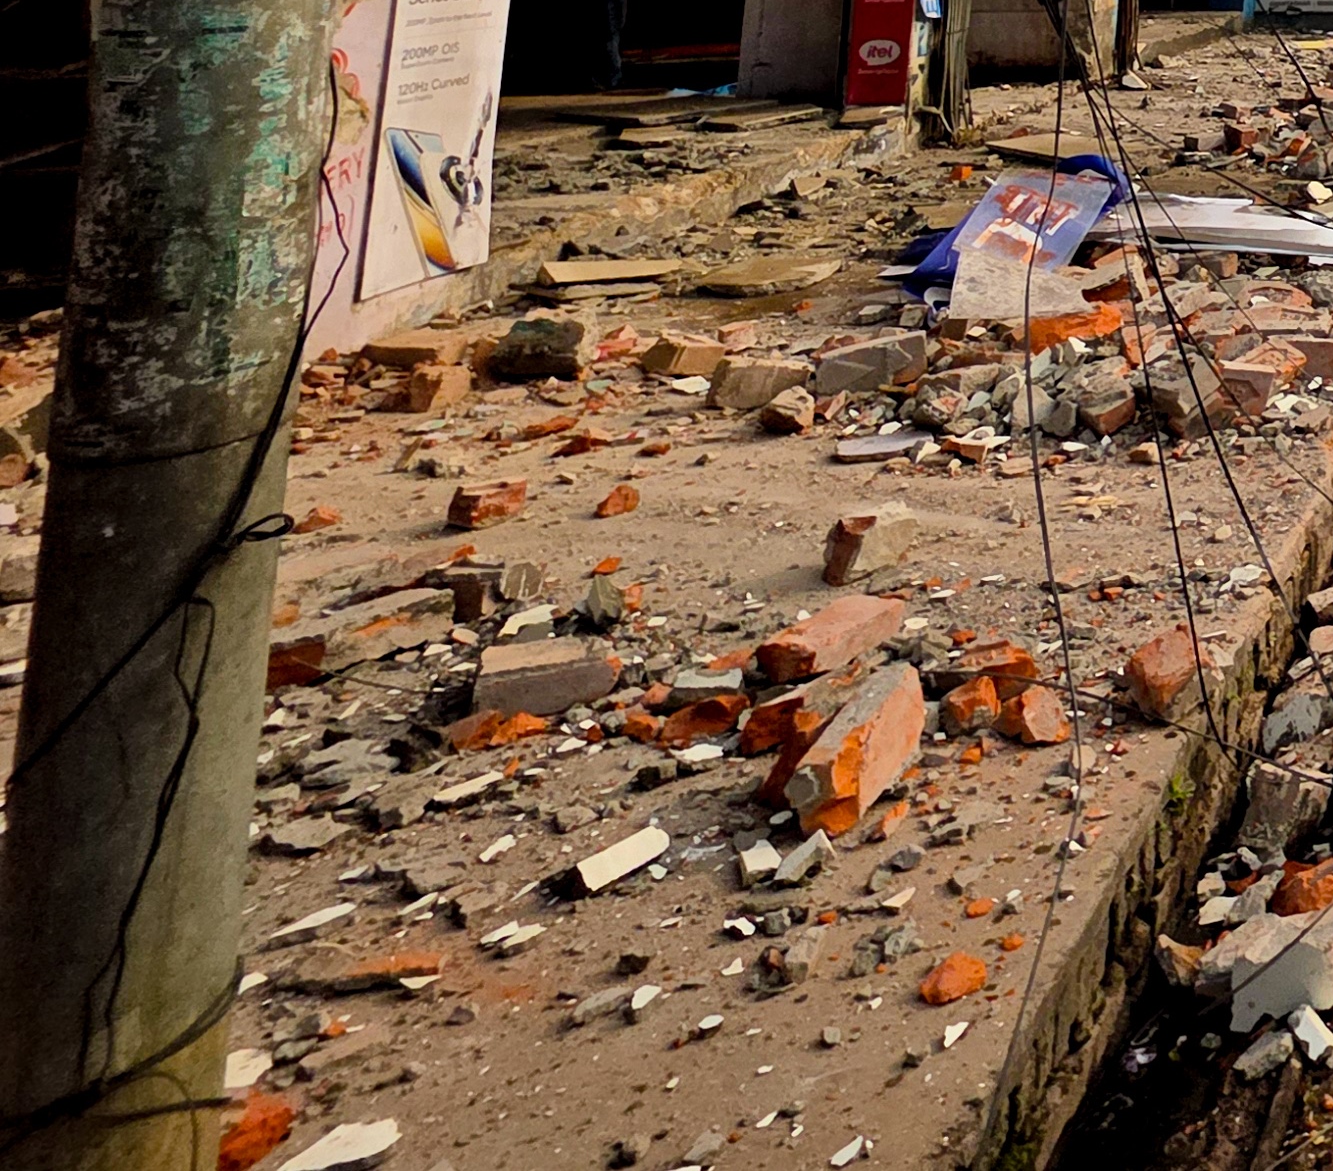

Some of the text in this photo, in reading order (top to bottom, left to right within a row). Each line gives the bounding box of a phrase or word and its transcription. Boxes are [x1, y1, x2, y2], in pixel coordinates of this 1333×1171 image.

[401, 44, 438, 62] 200MP
[866, 45, 893, 59] itel
[398, 74, 470, 97] 120Hz Curved
